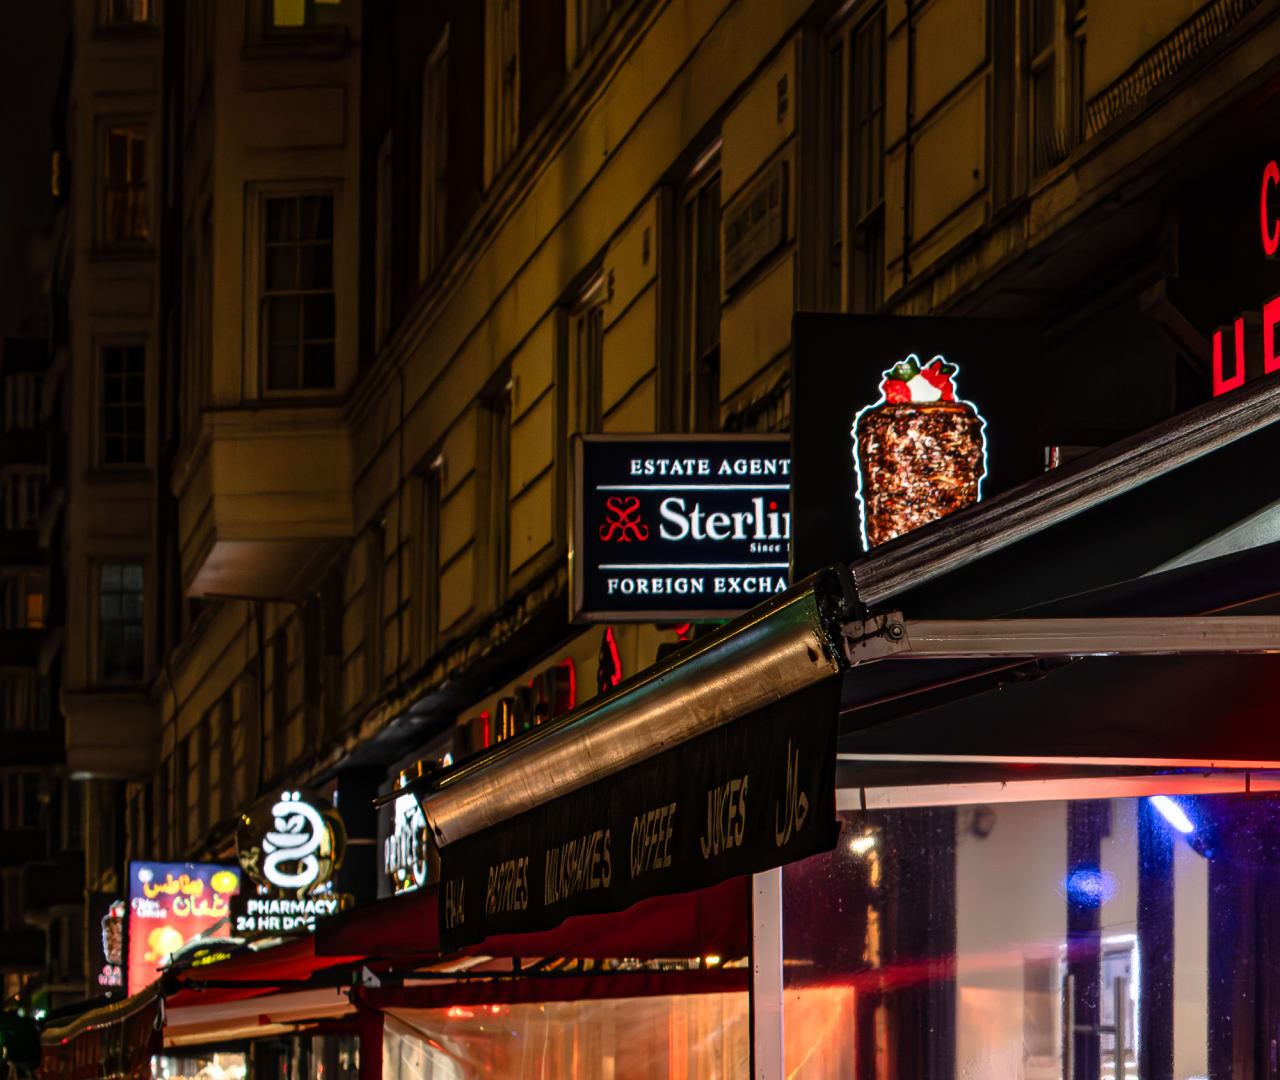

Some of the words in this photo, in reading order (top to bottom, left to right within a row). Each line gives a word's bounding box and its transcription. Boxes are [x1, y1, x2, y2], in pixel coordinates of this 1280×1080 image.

[630, 459, 710, 476] ESTATE
[749, 543, 781, 553] Since
[607, 578, 704, 595] FOREIGN
[485, 856, 530, 917] PASTRIES
[544, 828, 613, 907] MILKSHAKES
[629, 801, 678, 880] COFFEE
[701, 773, 750, 860] JUICES
[246, 899, 338, 915] PHARMACY
[236, 916, 256, 931] 24
[257, 916, 280, 931] HR
